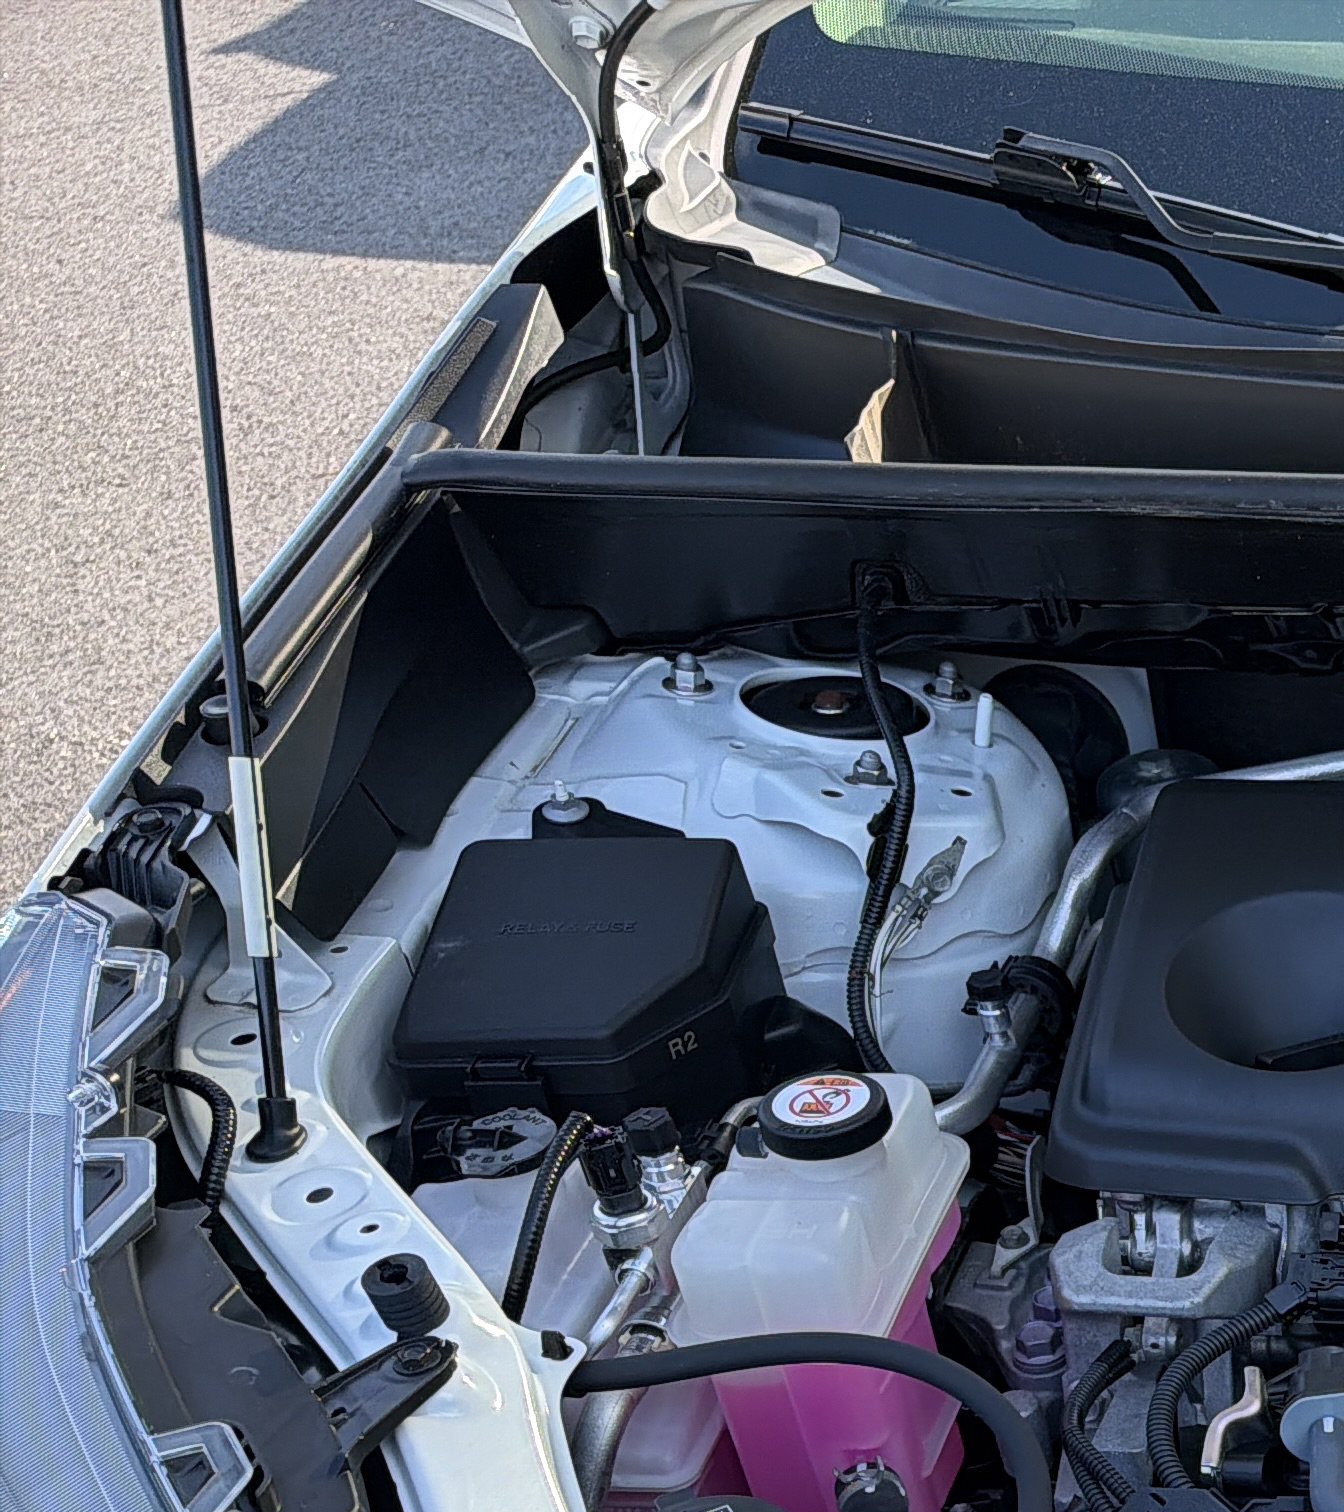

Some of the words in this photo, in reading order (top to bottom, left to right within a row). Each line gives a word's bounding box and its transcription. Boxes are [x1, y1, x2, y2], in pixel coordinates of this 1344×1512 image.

[498, 921, 565, 936] RELAY
[585, 920, 638, 934] FUSE
[668, 1031, 698, 1060] R2
[480, 1112, 548, 1127] COOLANT
